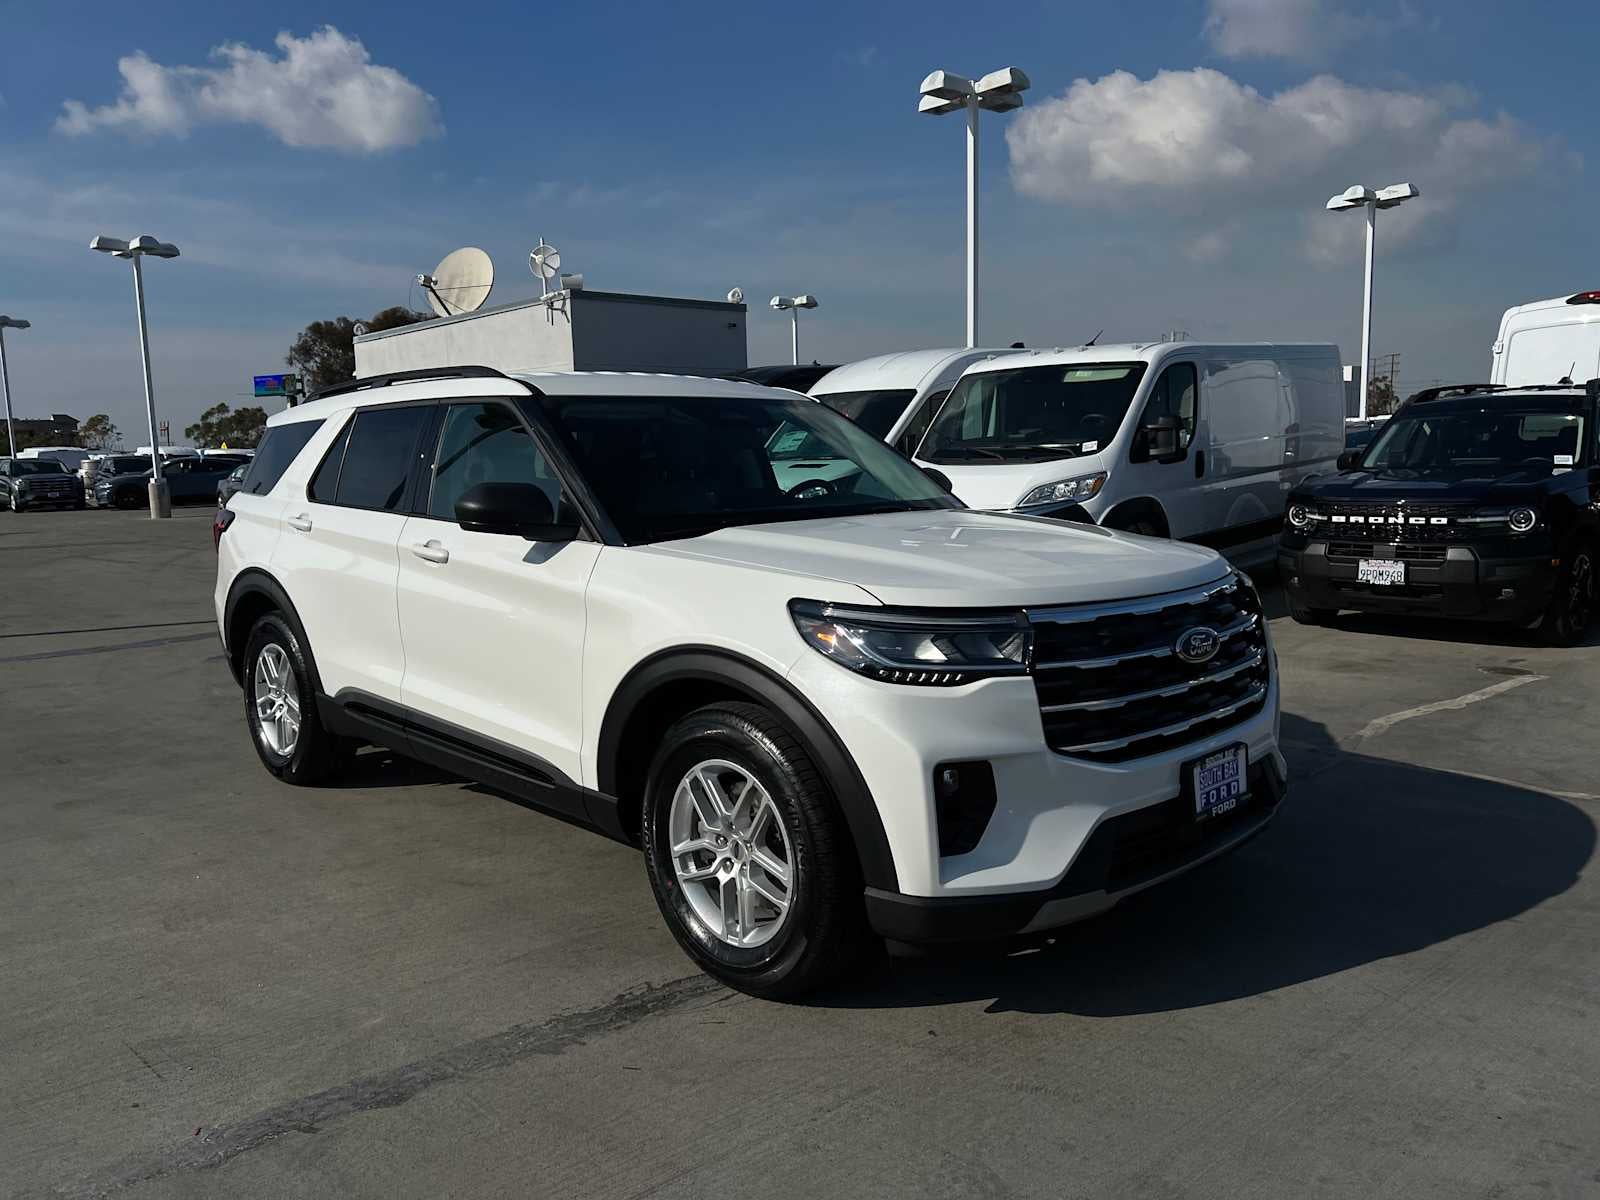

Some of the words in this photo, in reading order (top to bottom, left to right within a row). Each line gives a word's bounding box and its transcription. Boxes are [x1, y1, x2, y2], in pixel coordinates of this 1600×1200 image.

[1331, 515, 1448, 525] BRONCO
[1200, 764, 1223, 788] SOUTH
[1224, 759, 1238, 778] BAY
[1201, 781, 1238, 807] FORD
[1212, 799, 1237, 816] FORD
